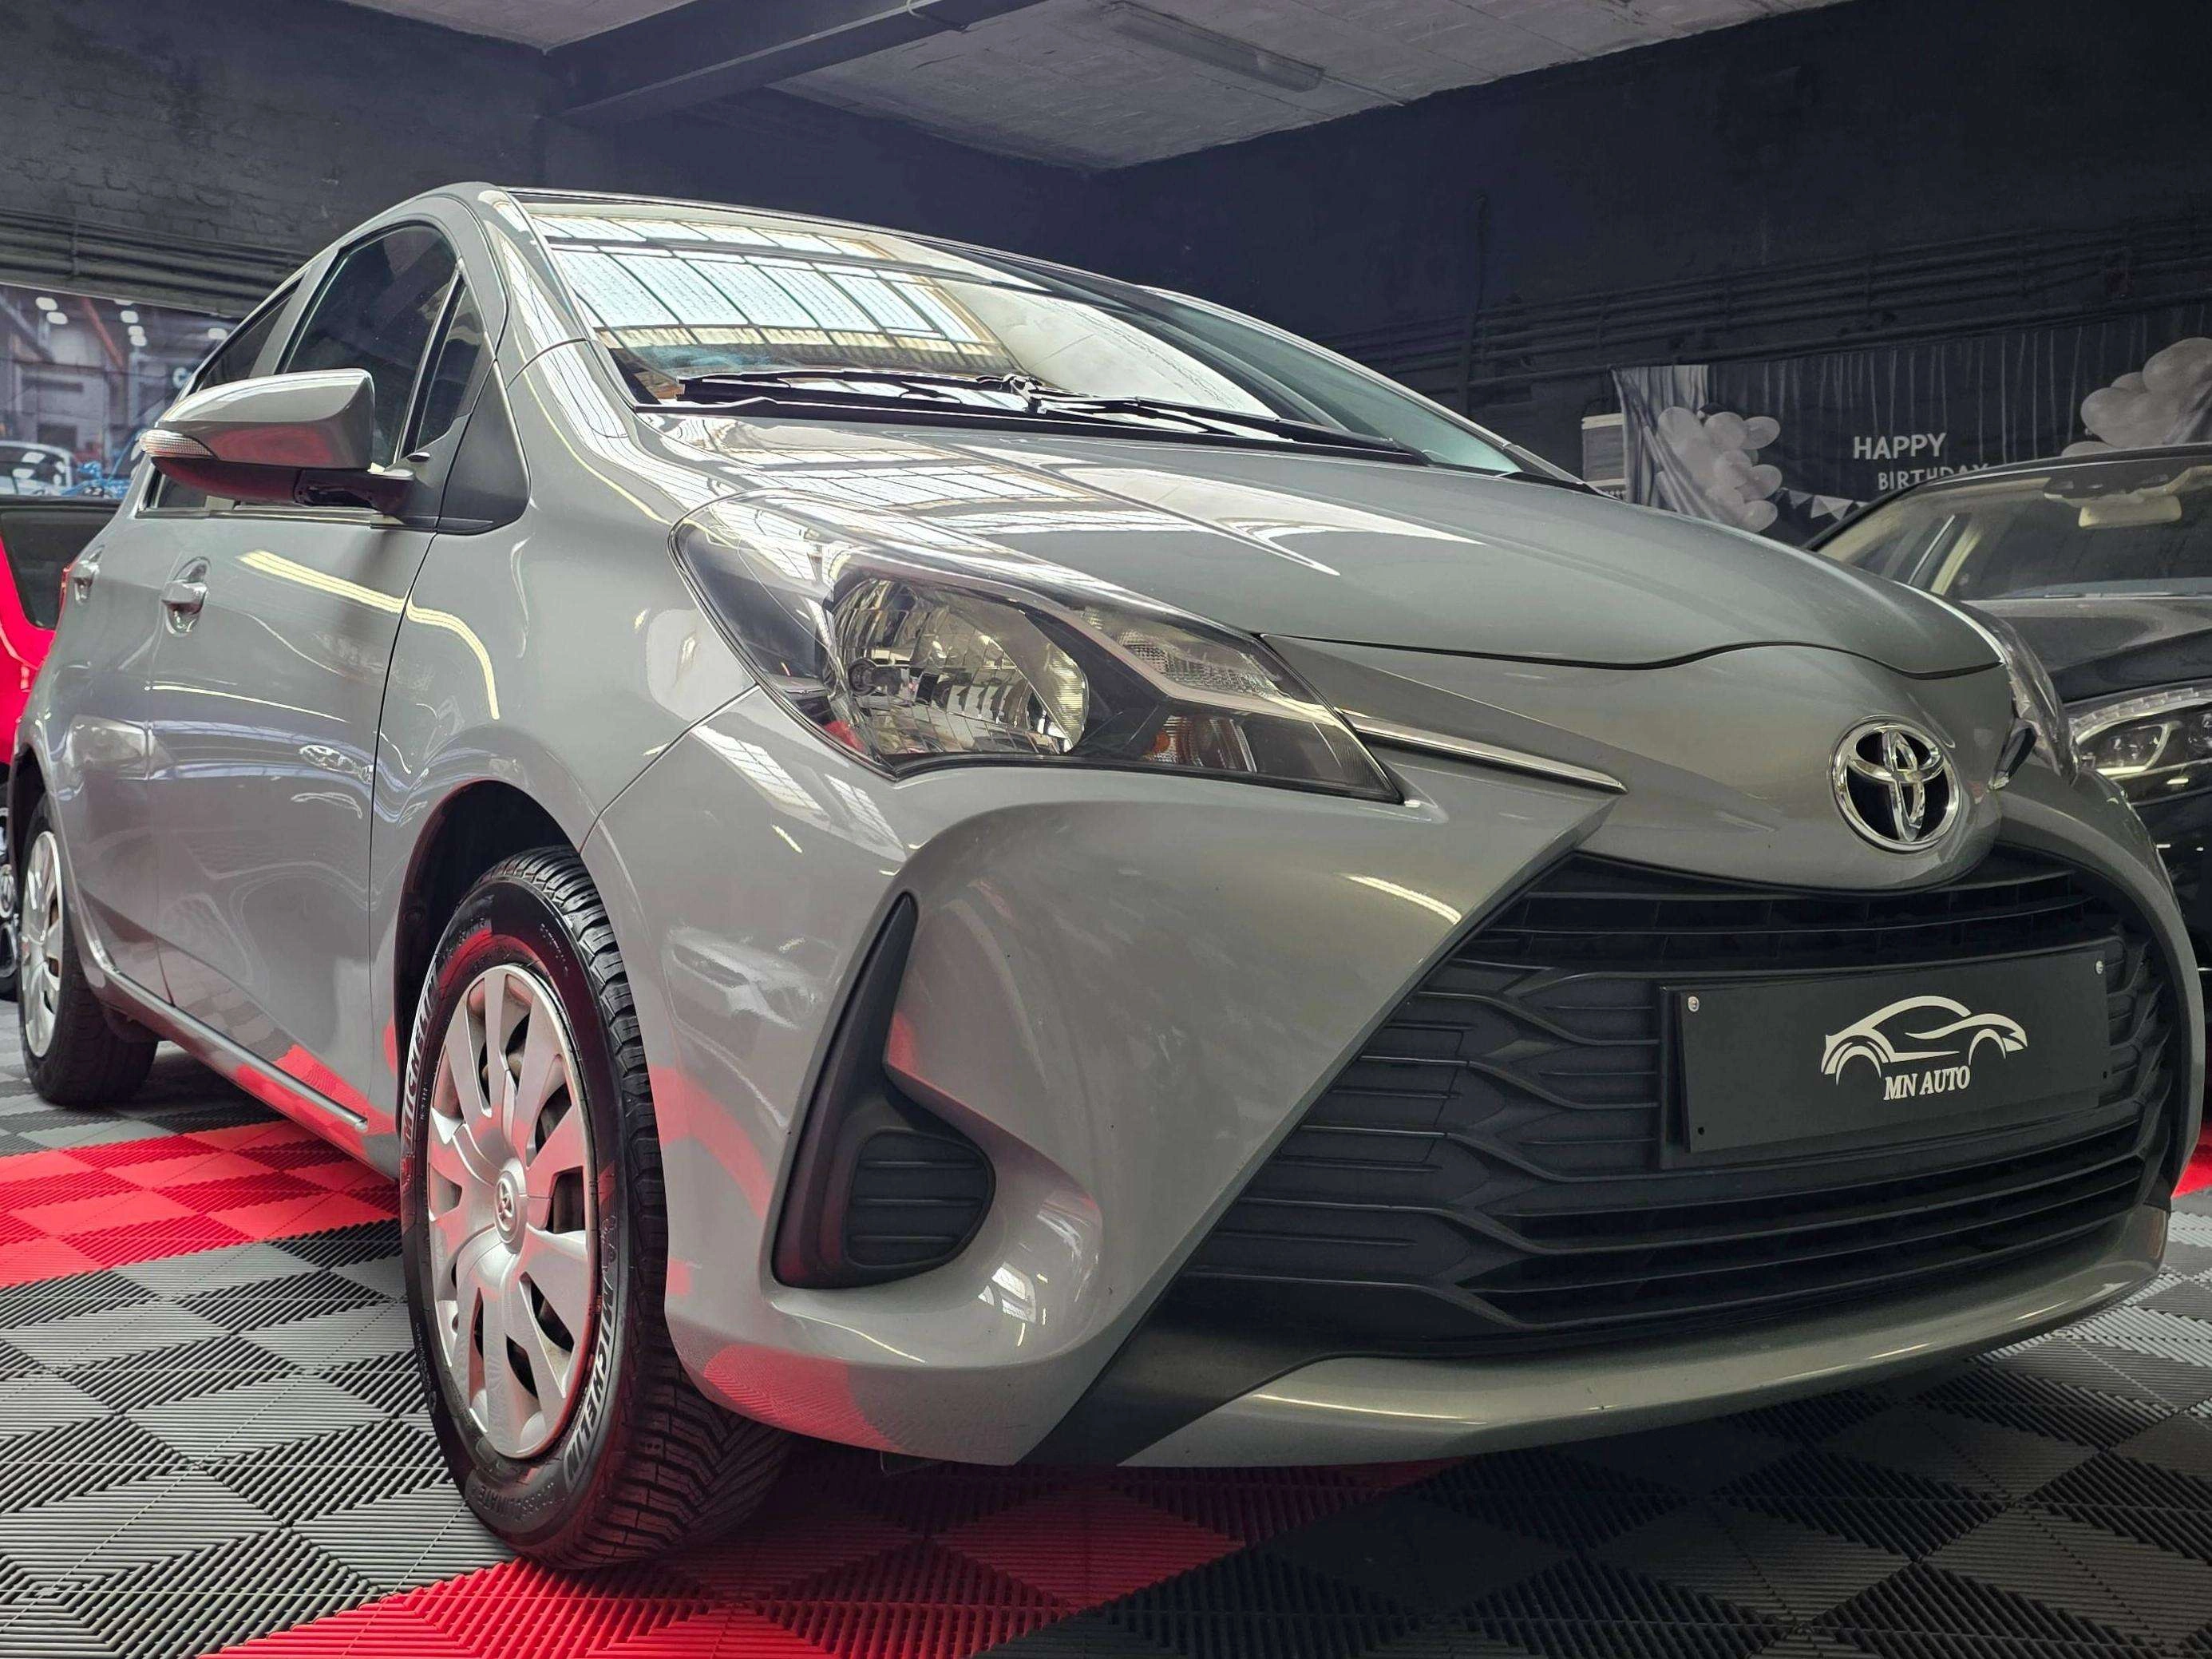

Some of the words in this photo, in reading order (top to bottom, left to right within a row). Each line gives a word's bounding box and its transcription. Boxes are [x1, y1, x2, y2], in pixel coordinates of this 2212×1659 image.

[1853, 433, 1947, 460] HAPPY
[402, 973, 437, 1146] MICHELIN
[1884, 1073, 1918, 1101] MN
[1919, 1066, 1971, 1095] AUTO
[564, 1281, 614, 1480] MICHELIN
